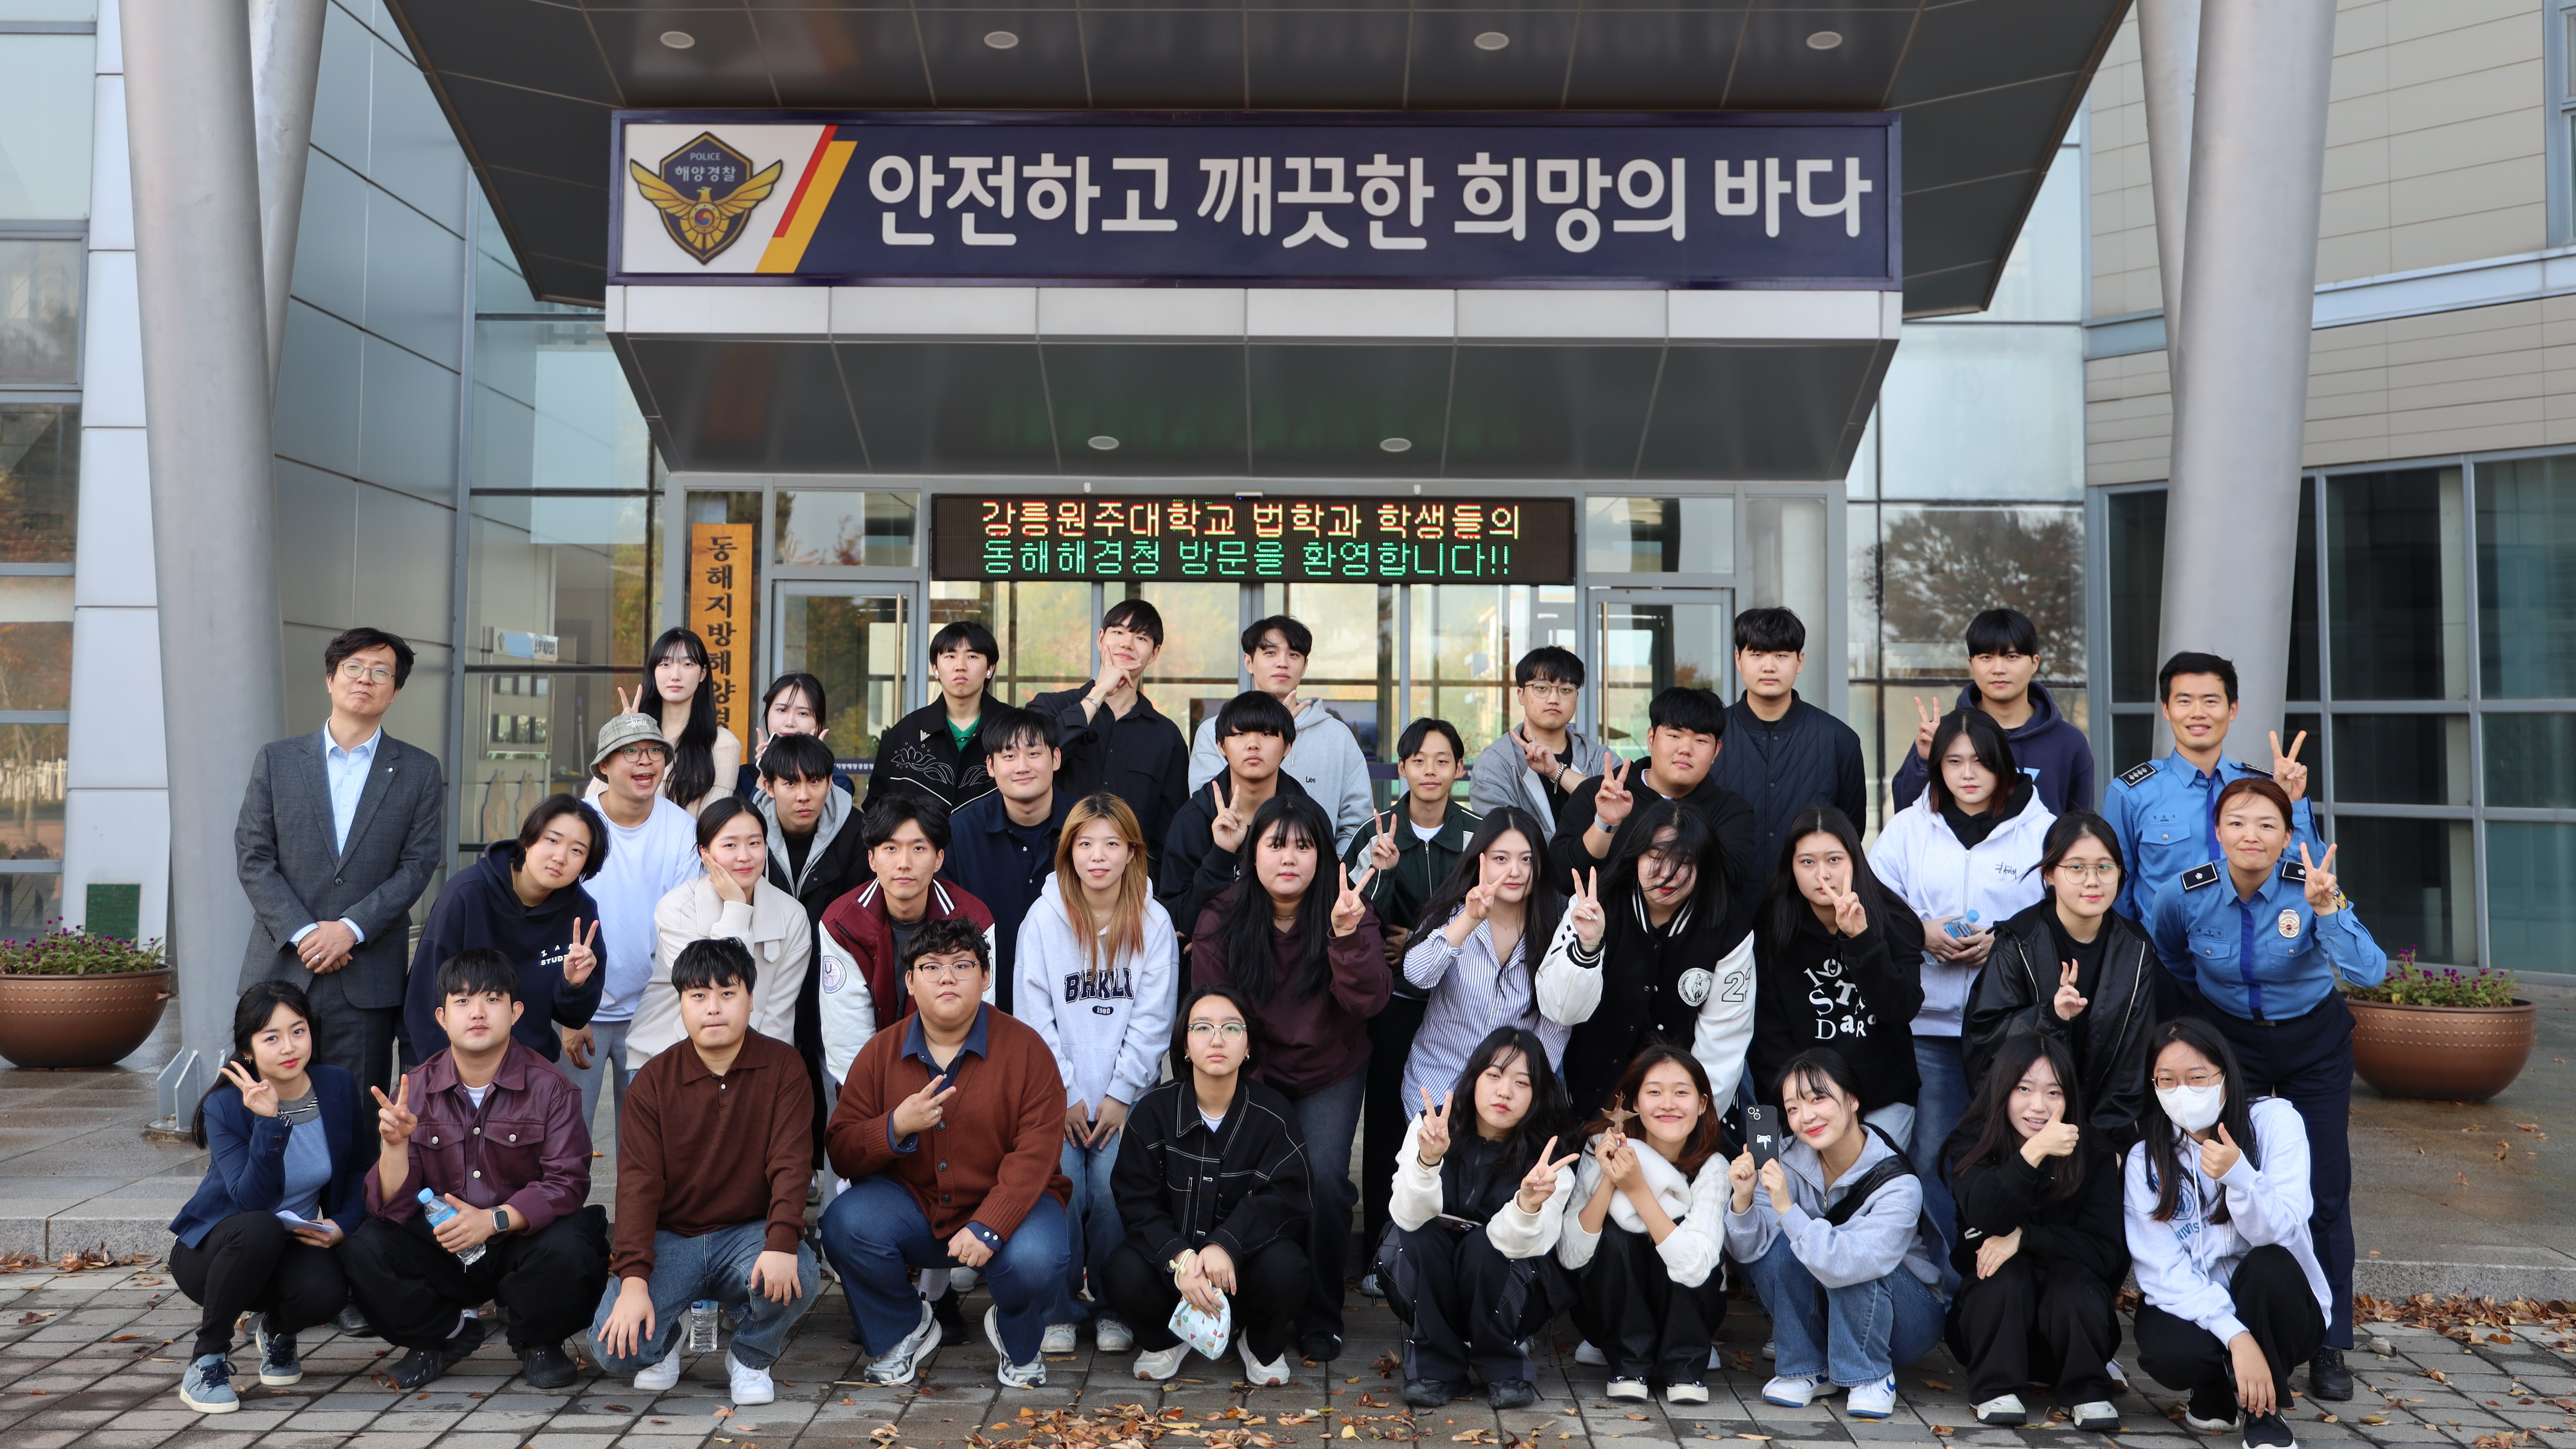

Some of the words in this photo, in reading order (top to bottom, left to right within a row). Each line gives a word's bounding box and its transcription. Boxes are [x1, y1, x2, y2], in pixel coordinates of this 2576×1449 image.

[690, 152, 721, 161] POLICE
[674, 165, 737, 182] 해양경찰
[868, 153, 1178, 246] 안전하고
[1197, 154, 1434, 250] 깨끗한
[1454, 152, 1686, 253] 희망의
[1715, 157, 1872, 238] 바다
[983, 501, 1236, 537] 강릉원주대학교
[1253, 503, 1362, 538] 법학과
[1377, 504, 1519, 540] 학생들의
[983, 540, 1159, 574] 동해해경청
[1179, 541, 1285, 575] 방문을
[1302, 542, 1508, 577] 환영합니다!!
[541, 954, 568, 966] STUD
